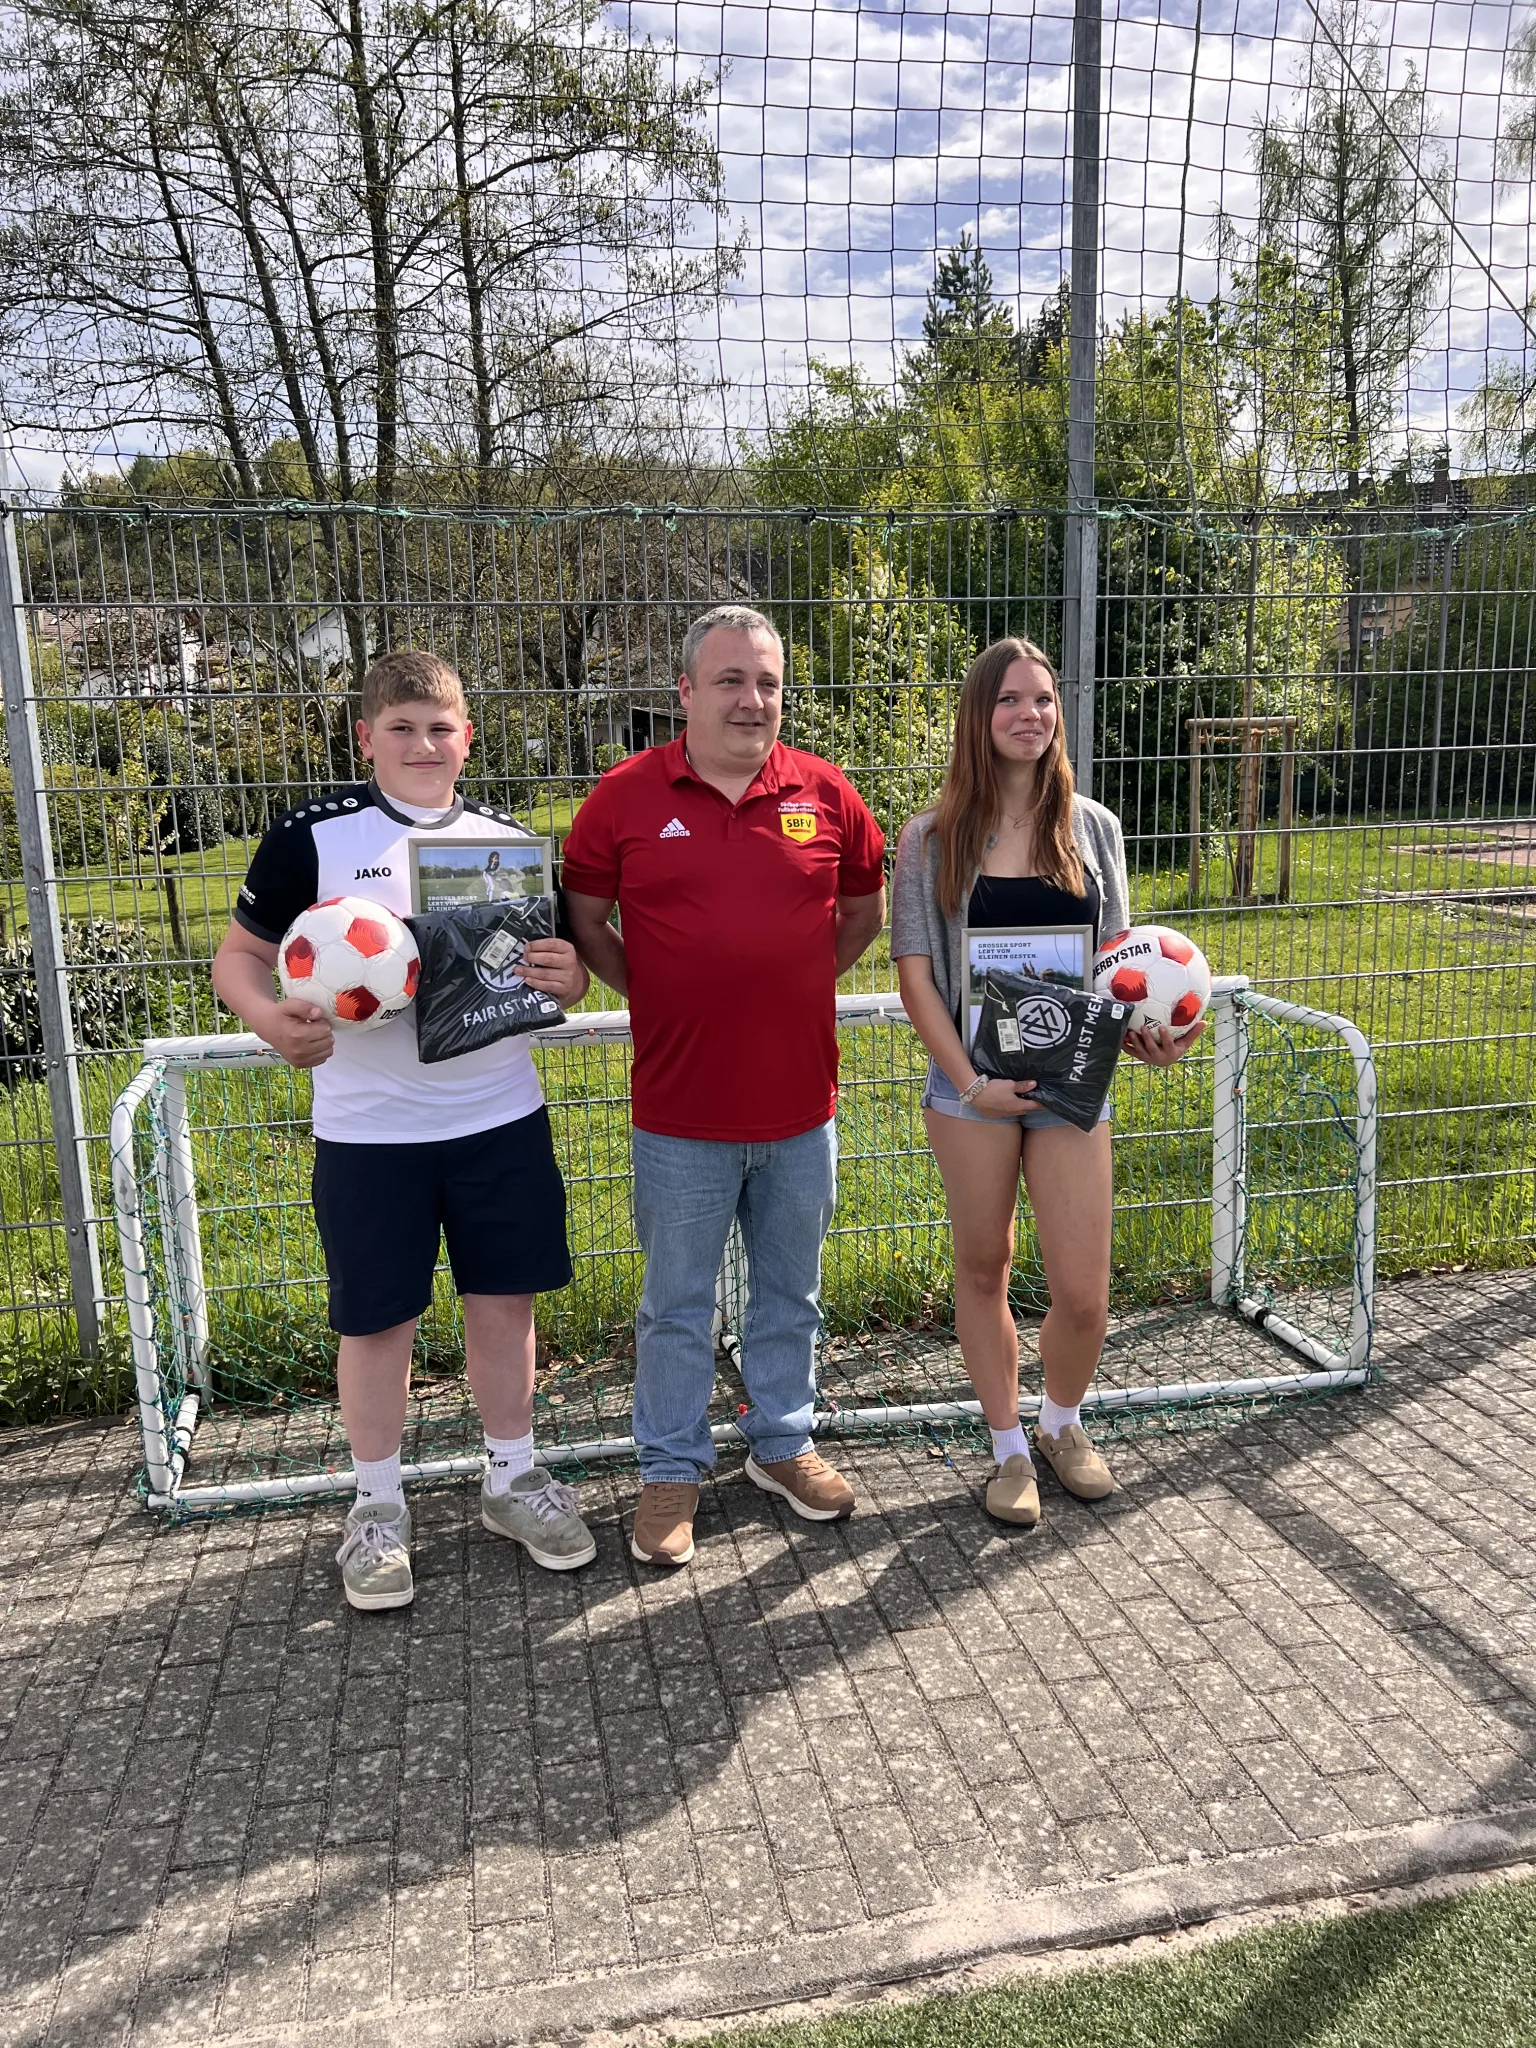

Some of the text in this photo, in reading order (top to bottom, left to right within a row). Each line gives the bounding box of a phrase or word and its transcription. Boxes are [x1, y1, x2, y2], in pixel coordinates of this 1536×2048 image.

[786, 818, 812, 828] SBFV
[659, 829, 691, 839] adidas
[354, 866, 392, 880] JAKO
[463, 1005, 498, 1028] FAIR
[499, 998, 522, 1017] IST
[522, 990, 549, 1009] ME
[1146, 1020, 1162, 1030] ELECT
[1077, 1026, 1095, 1048] IST
[1068, 1050, 1089, 1082] FAIR
